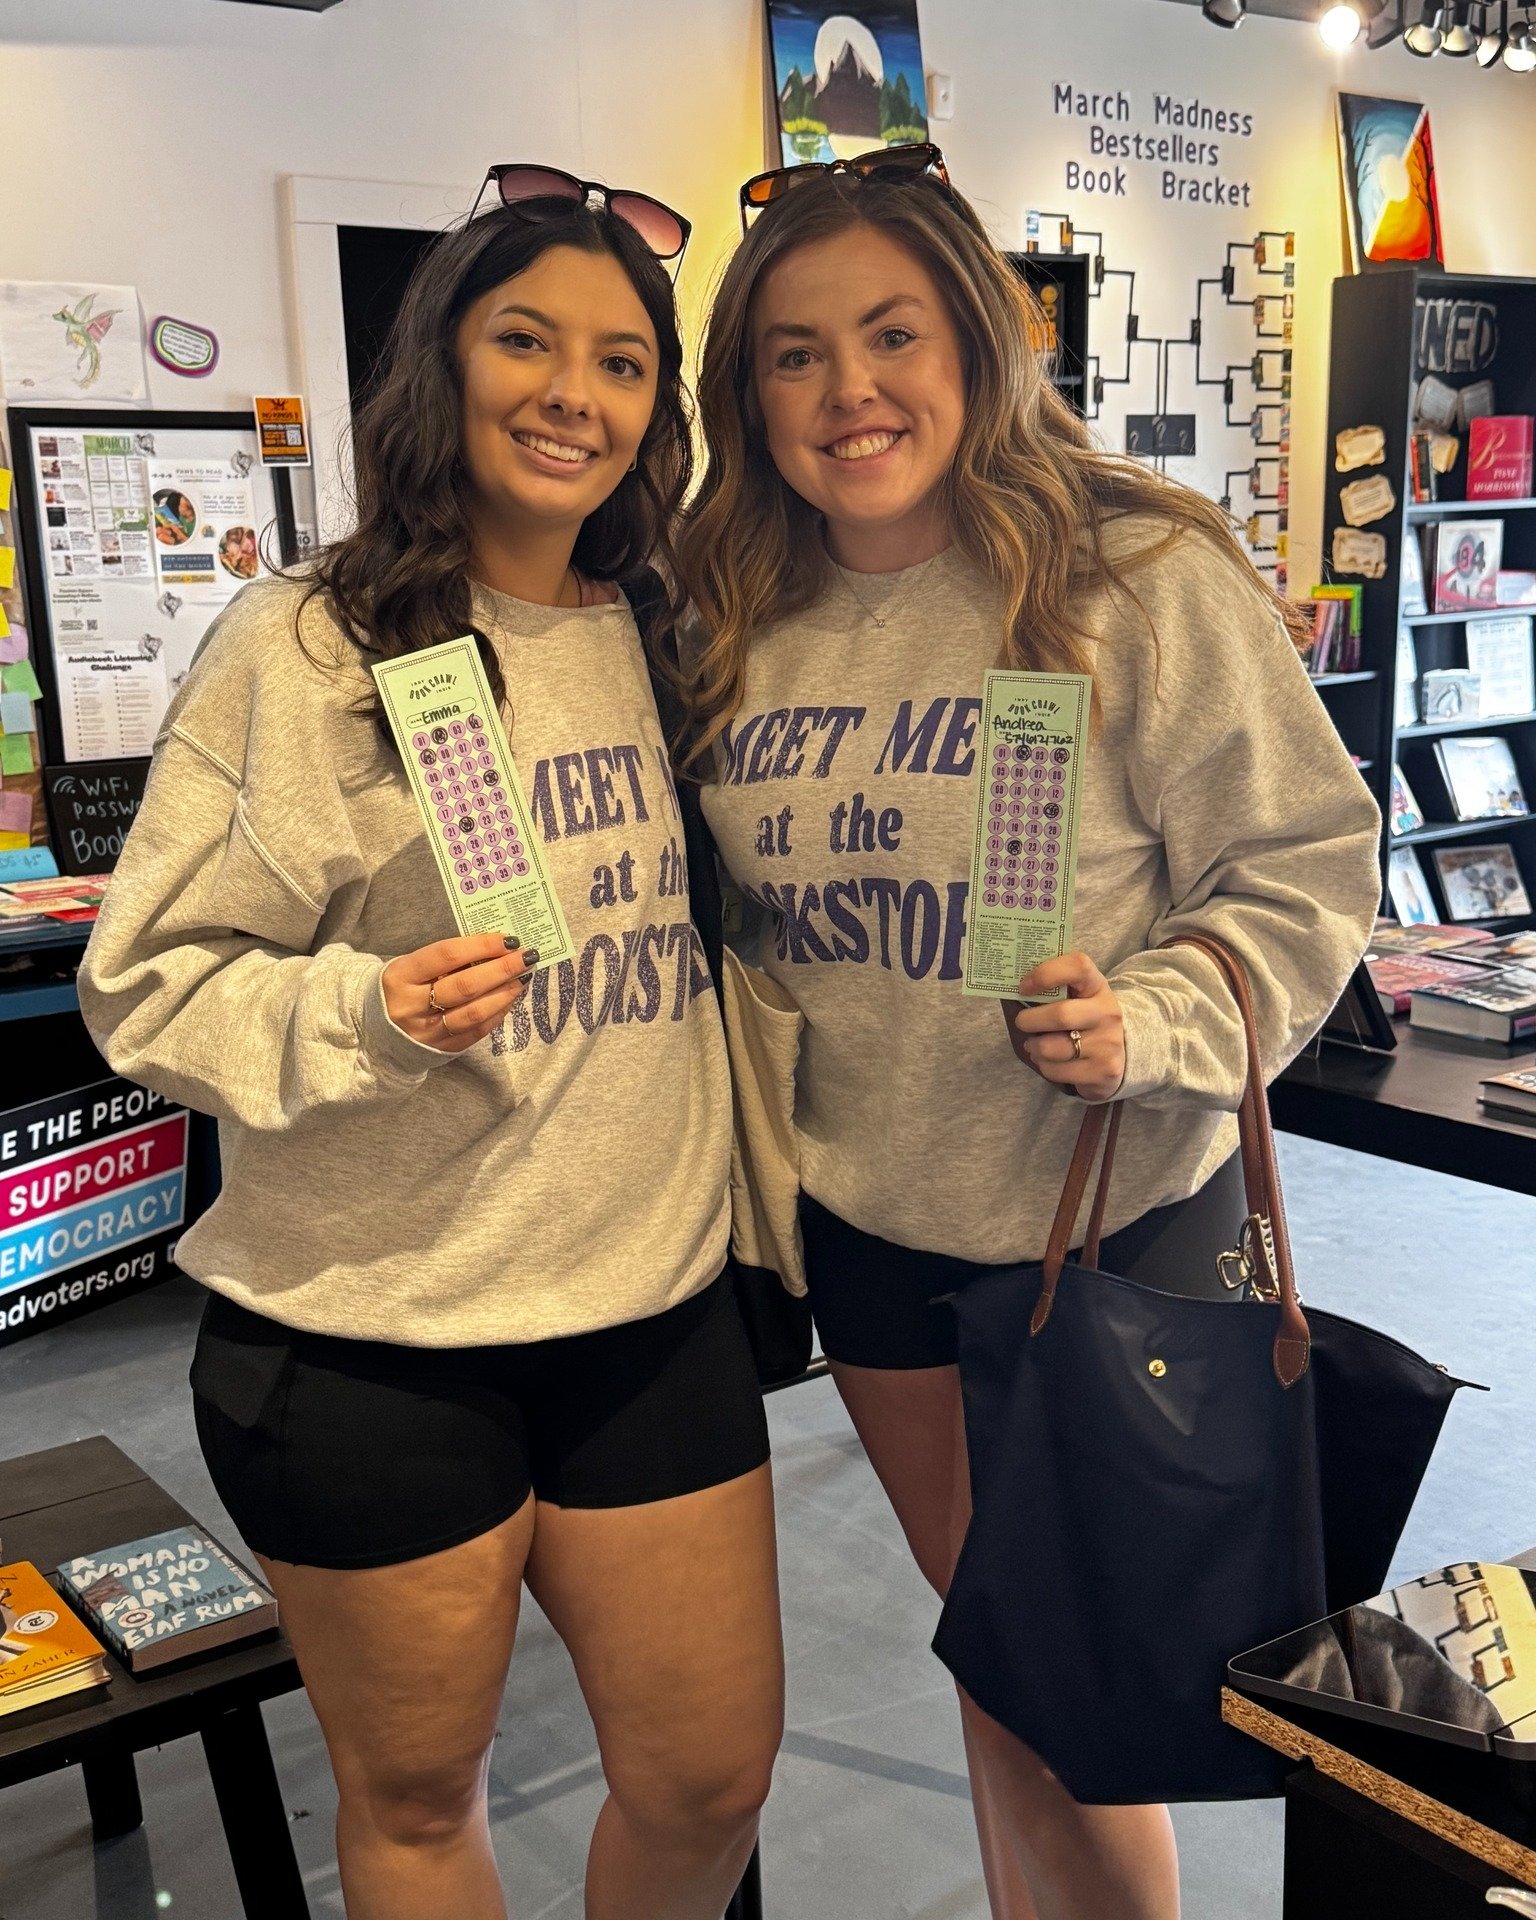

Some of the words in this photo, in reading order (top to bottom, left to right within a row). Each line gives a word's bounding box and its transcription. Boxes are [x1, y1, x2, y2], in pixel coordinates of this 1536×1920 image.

[1054, 84, 1129, 122] March
[1154, 96, 1253, 137] Madness
[1090, 125, 1219, 167] Bestsellers
[1066, 161, 1127, 197] Book
[1162, 171, 1251, 208] Bracket
[1414, 297, 1498, 374] NED
[409, 685, 431, 700] BOOK
[428, 674, 458, 688] CRAWL
[422, 704, 461, 725] Emma
[991, 714, 1047, 732] Andrea
[721, 706, 866, 787] MEET
[874, 697, 983, 776] ME
[80, 776, 129, 797] WiFi
[531, 745, 650, 843] MEET
[754, 804, 794, 857] at
[828, 792, 904, 855] the
[590, 851, 639, 909] at
[658, 836, 689, 898] th
[0, 1129, 18, 1161] E
[27, 1109, 83, 1151] THE
[9, 1140, 155, 1217] SUPPORT
[0, 1186, 178, 1279] EMOCRACY
[0, 1250, 156, 1331] advoters.org
[71, 1539, 204, 1590] WOMAN
[71, 1557, 96, 1574] A
[132, 1569, 162, 1590] IS
[166, 1557, 210, 1581] NO
[101, 1576, 201, 1622] MAN
[123, 1611, 187, 1649] ETAF
[195, 1591, 263, 1622] RUM
[164, 1602, 177, 1616] A
[182, 1584, 243, 1609] NOVEL
